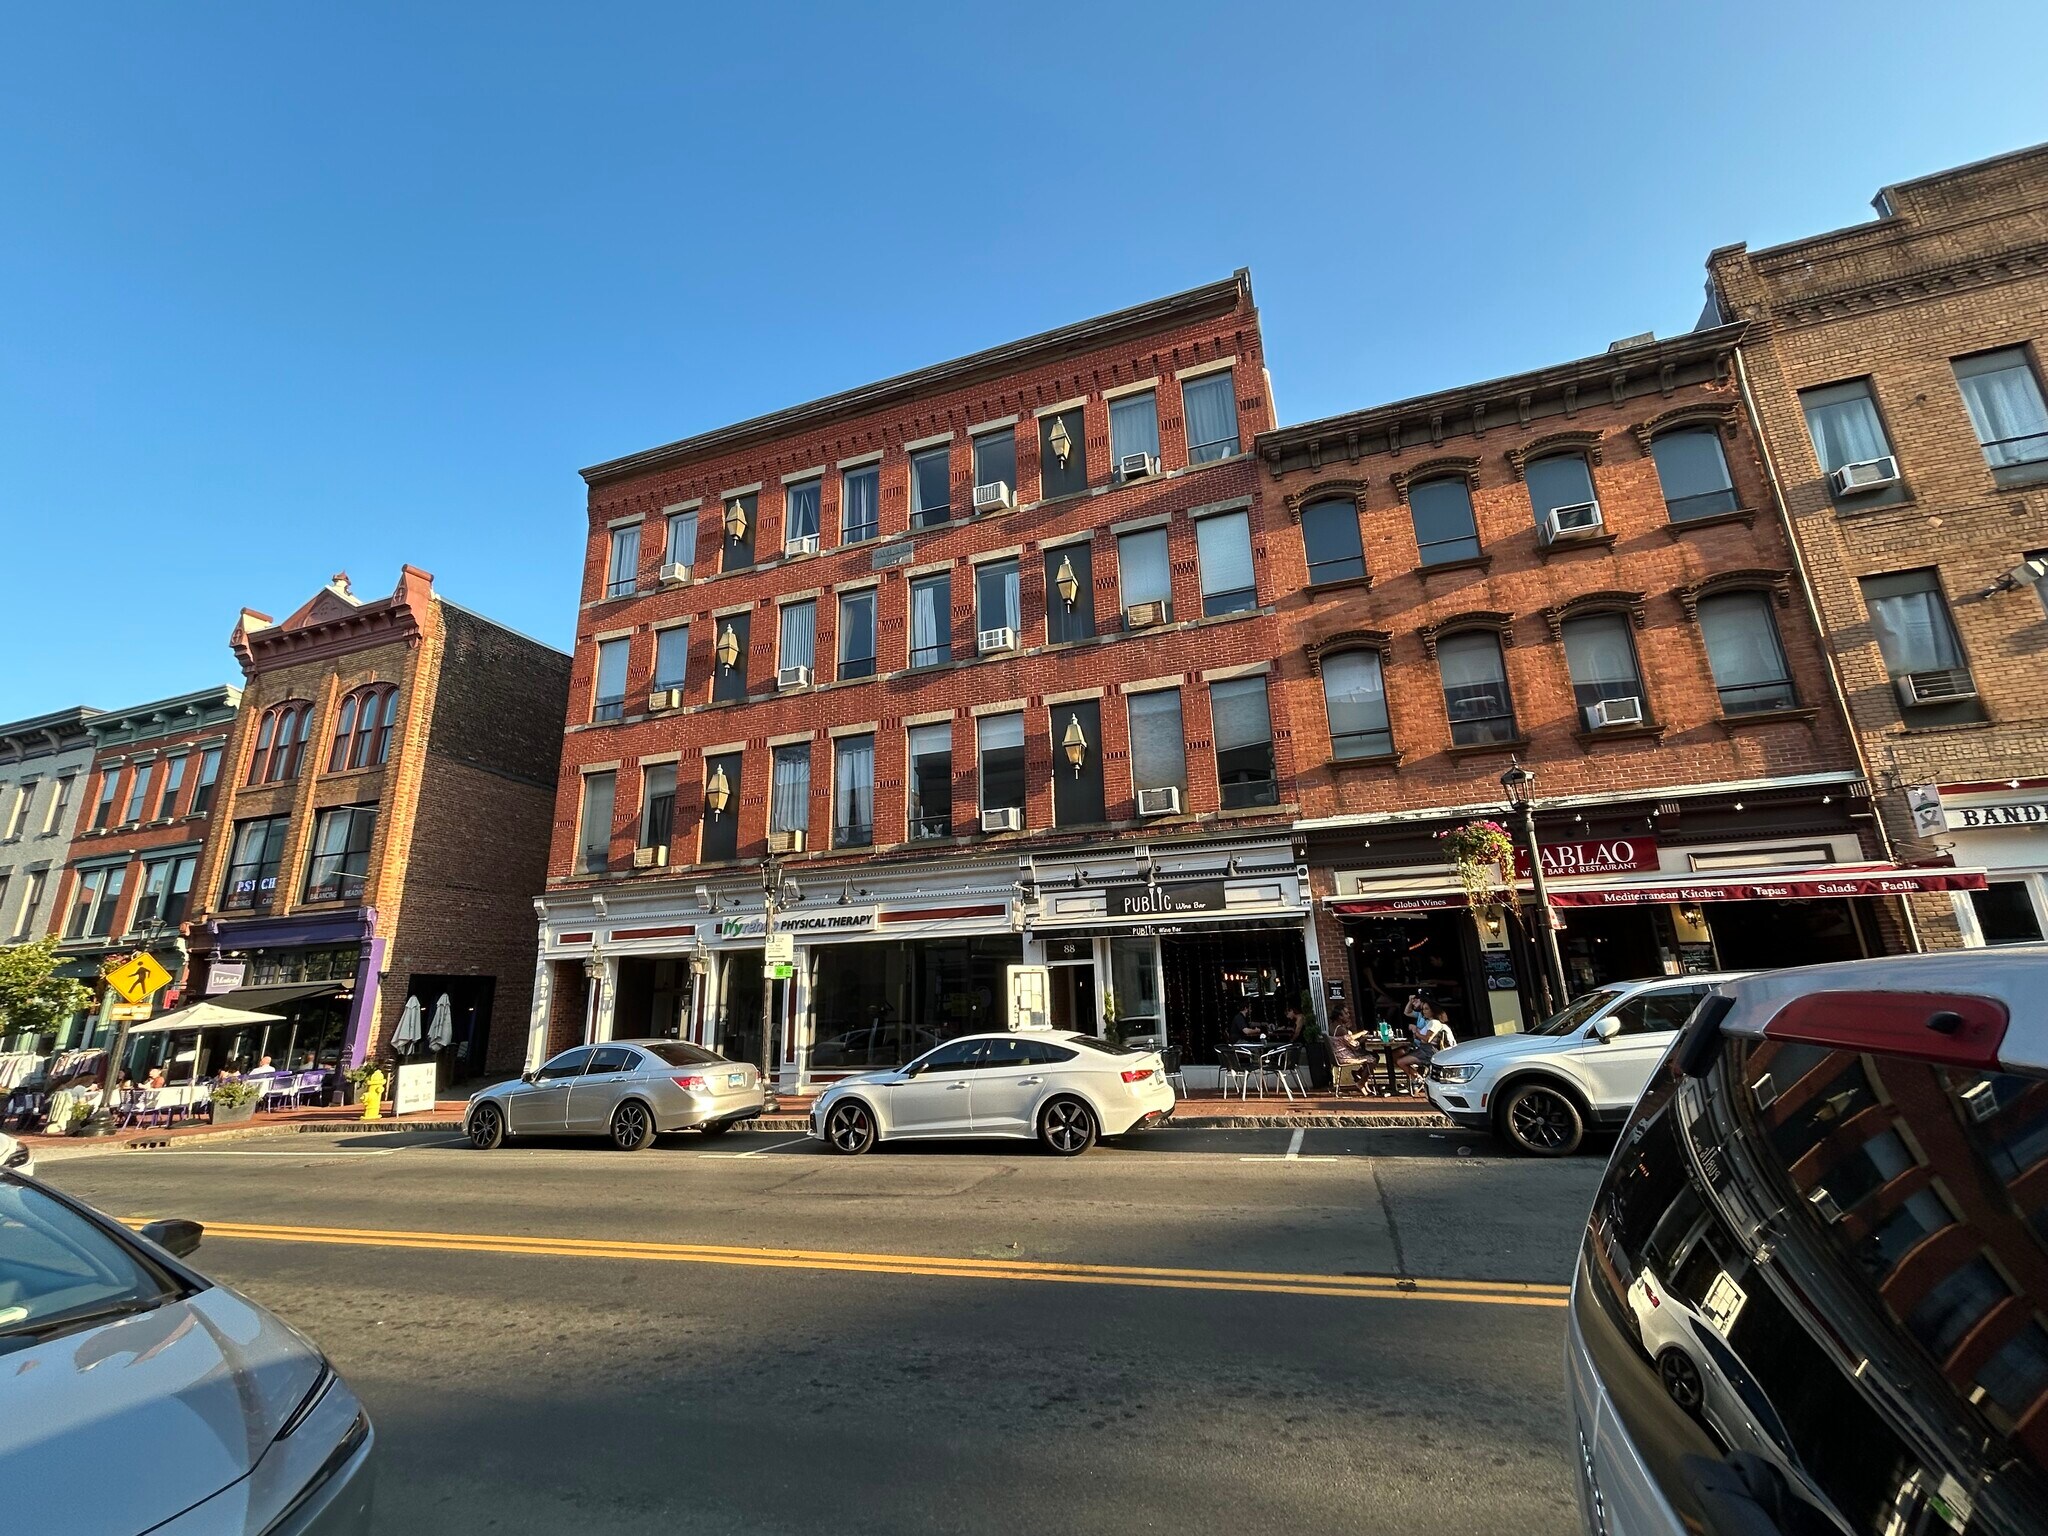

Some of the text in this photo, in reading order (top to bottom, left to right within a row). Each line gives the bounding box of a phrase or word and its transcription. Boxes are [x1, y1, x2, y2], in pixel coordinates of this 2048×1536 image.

[1521, 841, 1634, 868] ABLAO
[1521, 862, 1638, 877] WIE BAR & RESTAURANT
[1604, 879, 1919, 902] Mediterranean Kitchen Tapas Salads Paella
[1124, 886, 1206, 913] PUBLIC Wine Bar
[1393, 899, 1447, 909] Global Wines
[780, 917, 827, 931] PHYSICAL
[828, 914, 873, 928] THERAPY
[1132, 925, 1156, 935] PUBLIC
[1063, 944, 1076, 953] 88
